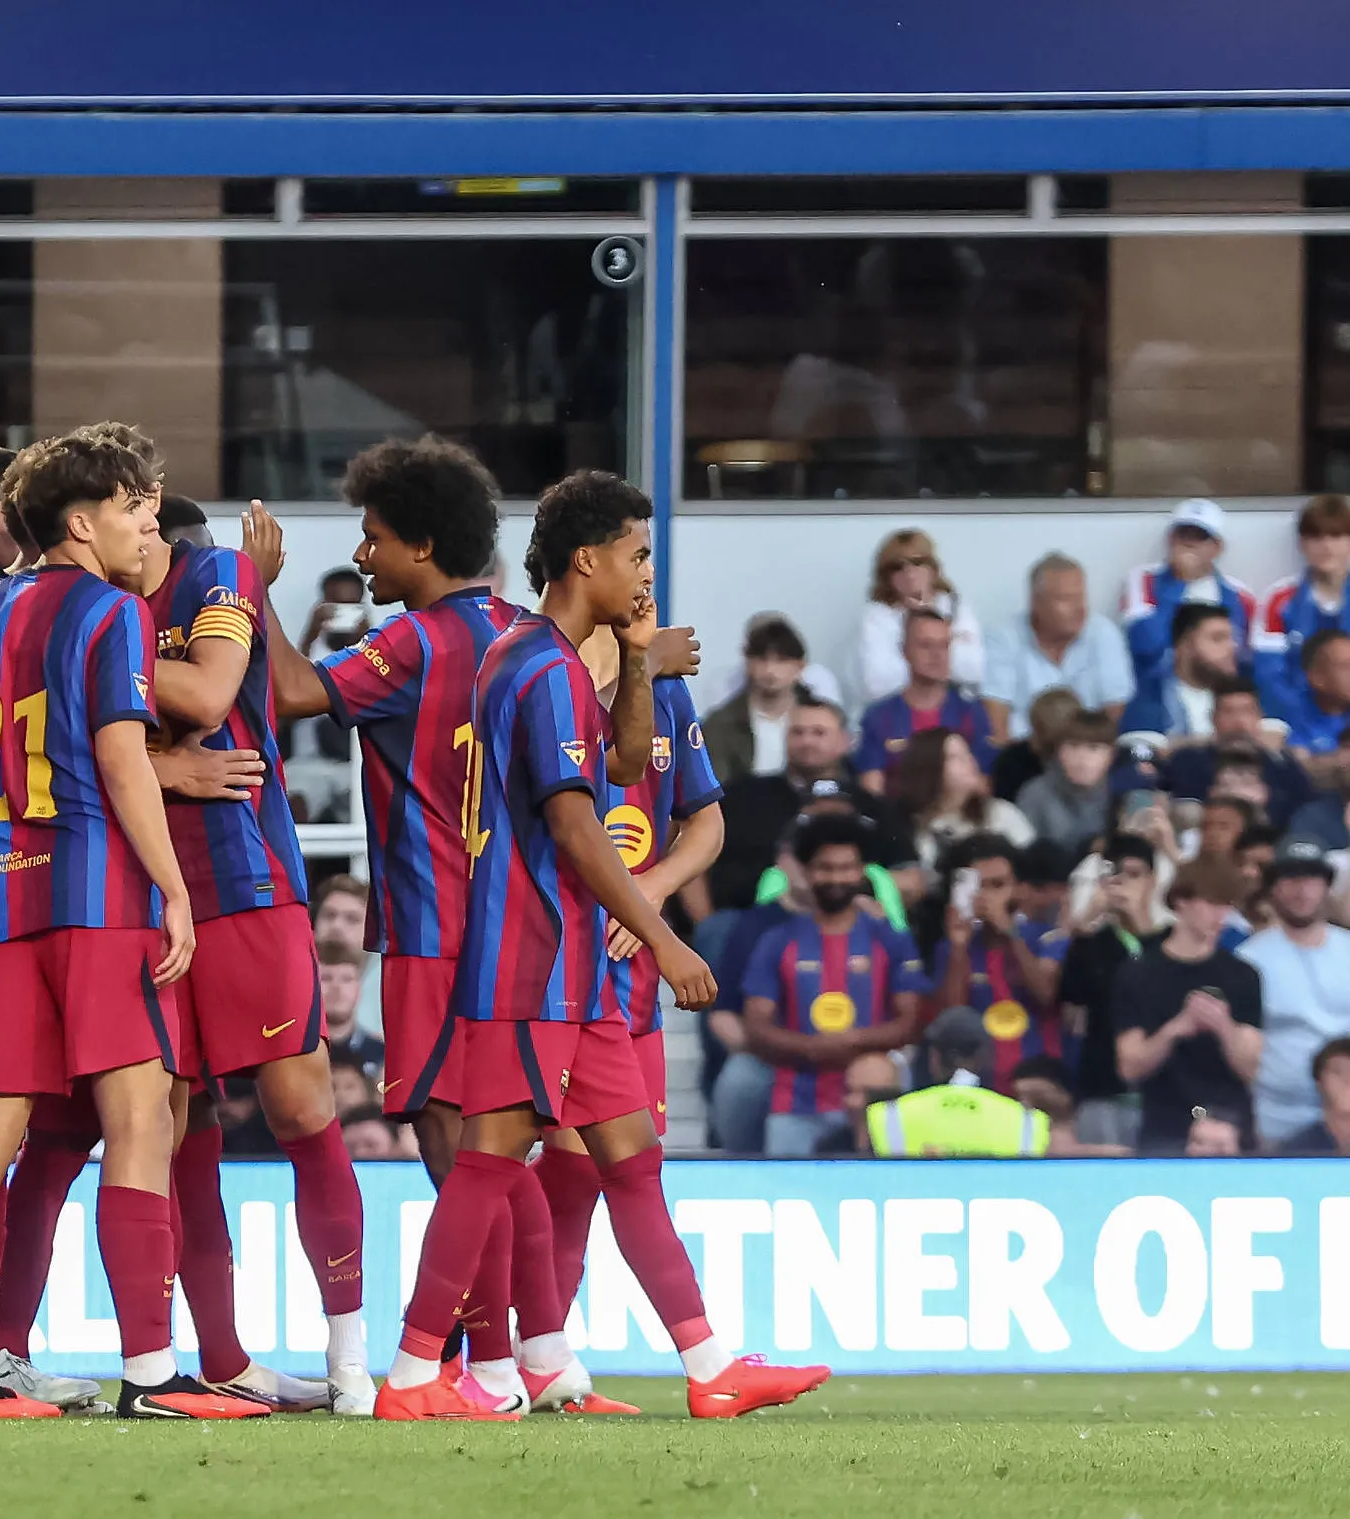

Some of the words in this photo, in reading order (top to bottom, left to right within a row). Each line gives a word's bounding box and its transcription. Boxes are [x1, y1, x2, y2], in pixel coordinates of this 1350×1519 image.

[607, 247, 628, 271] 3
[400, 1198, 1071, 1352] TNER
[1093, 1195, 1293, 1352] OF
